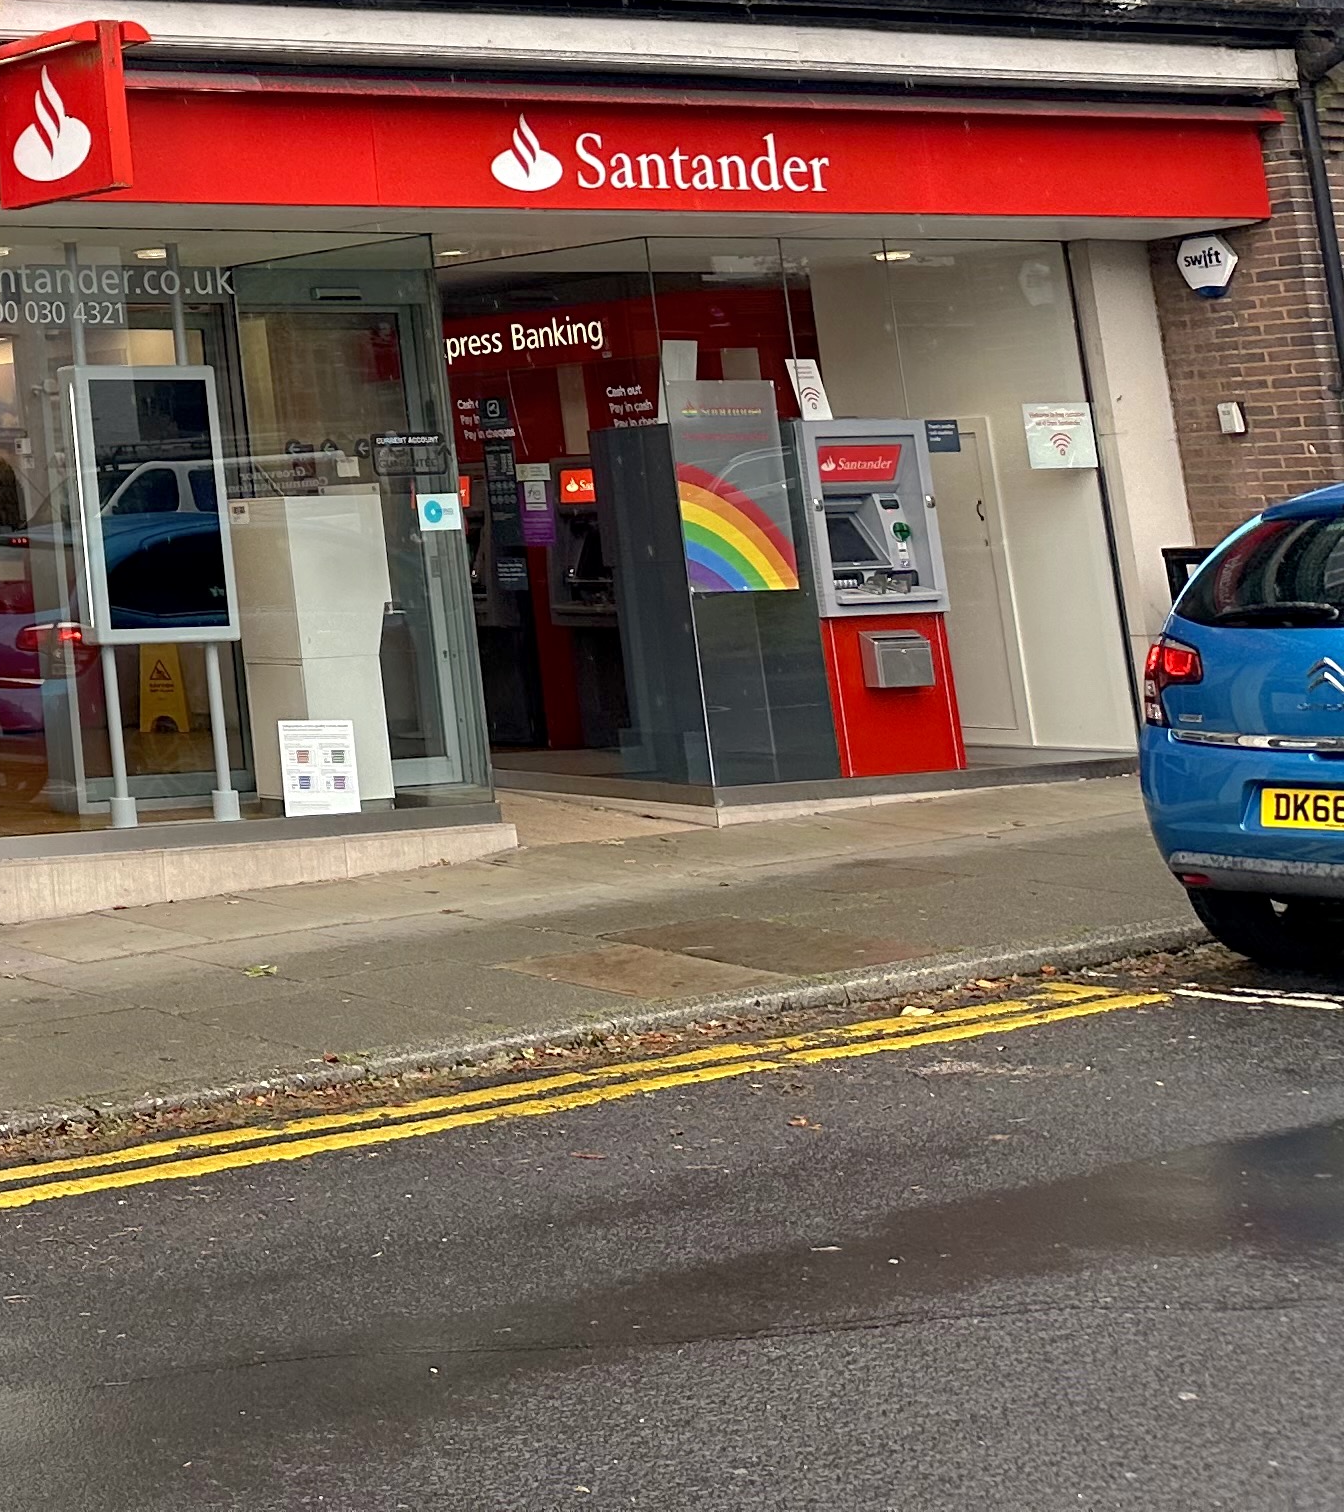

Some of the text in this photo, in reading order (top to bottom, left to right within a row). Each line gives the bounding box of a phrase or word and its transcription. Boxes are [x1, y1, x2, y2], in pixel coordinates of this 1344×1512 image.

[574, 133, 830, 193] Santander
[1183, 246, 1221, 268] swift
[24, 300, 67, 324] 030
[73, 300, 126, 324] 4321
[444, 316, 604, 365] press Banking
[408, 435, 439, 444] ACCOUNT
[836, 455, 893, 471] Santander
